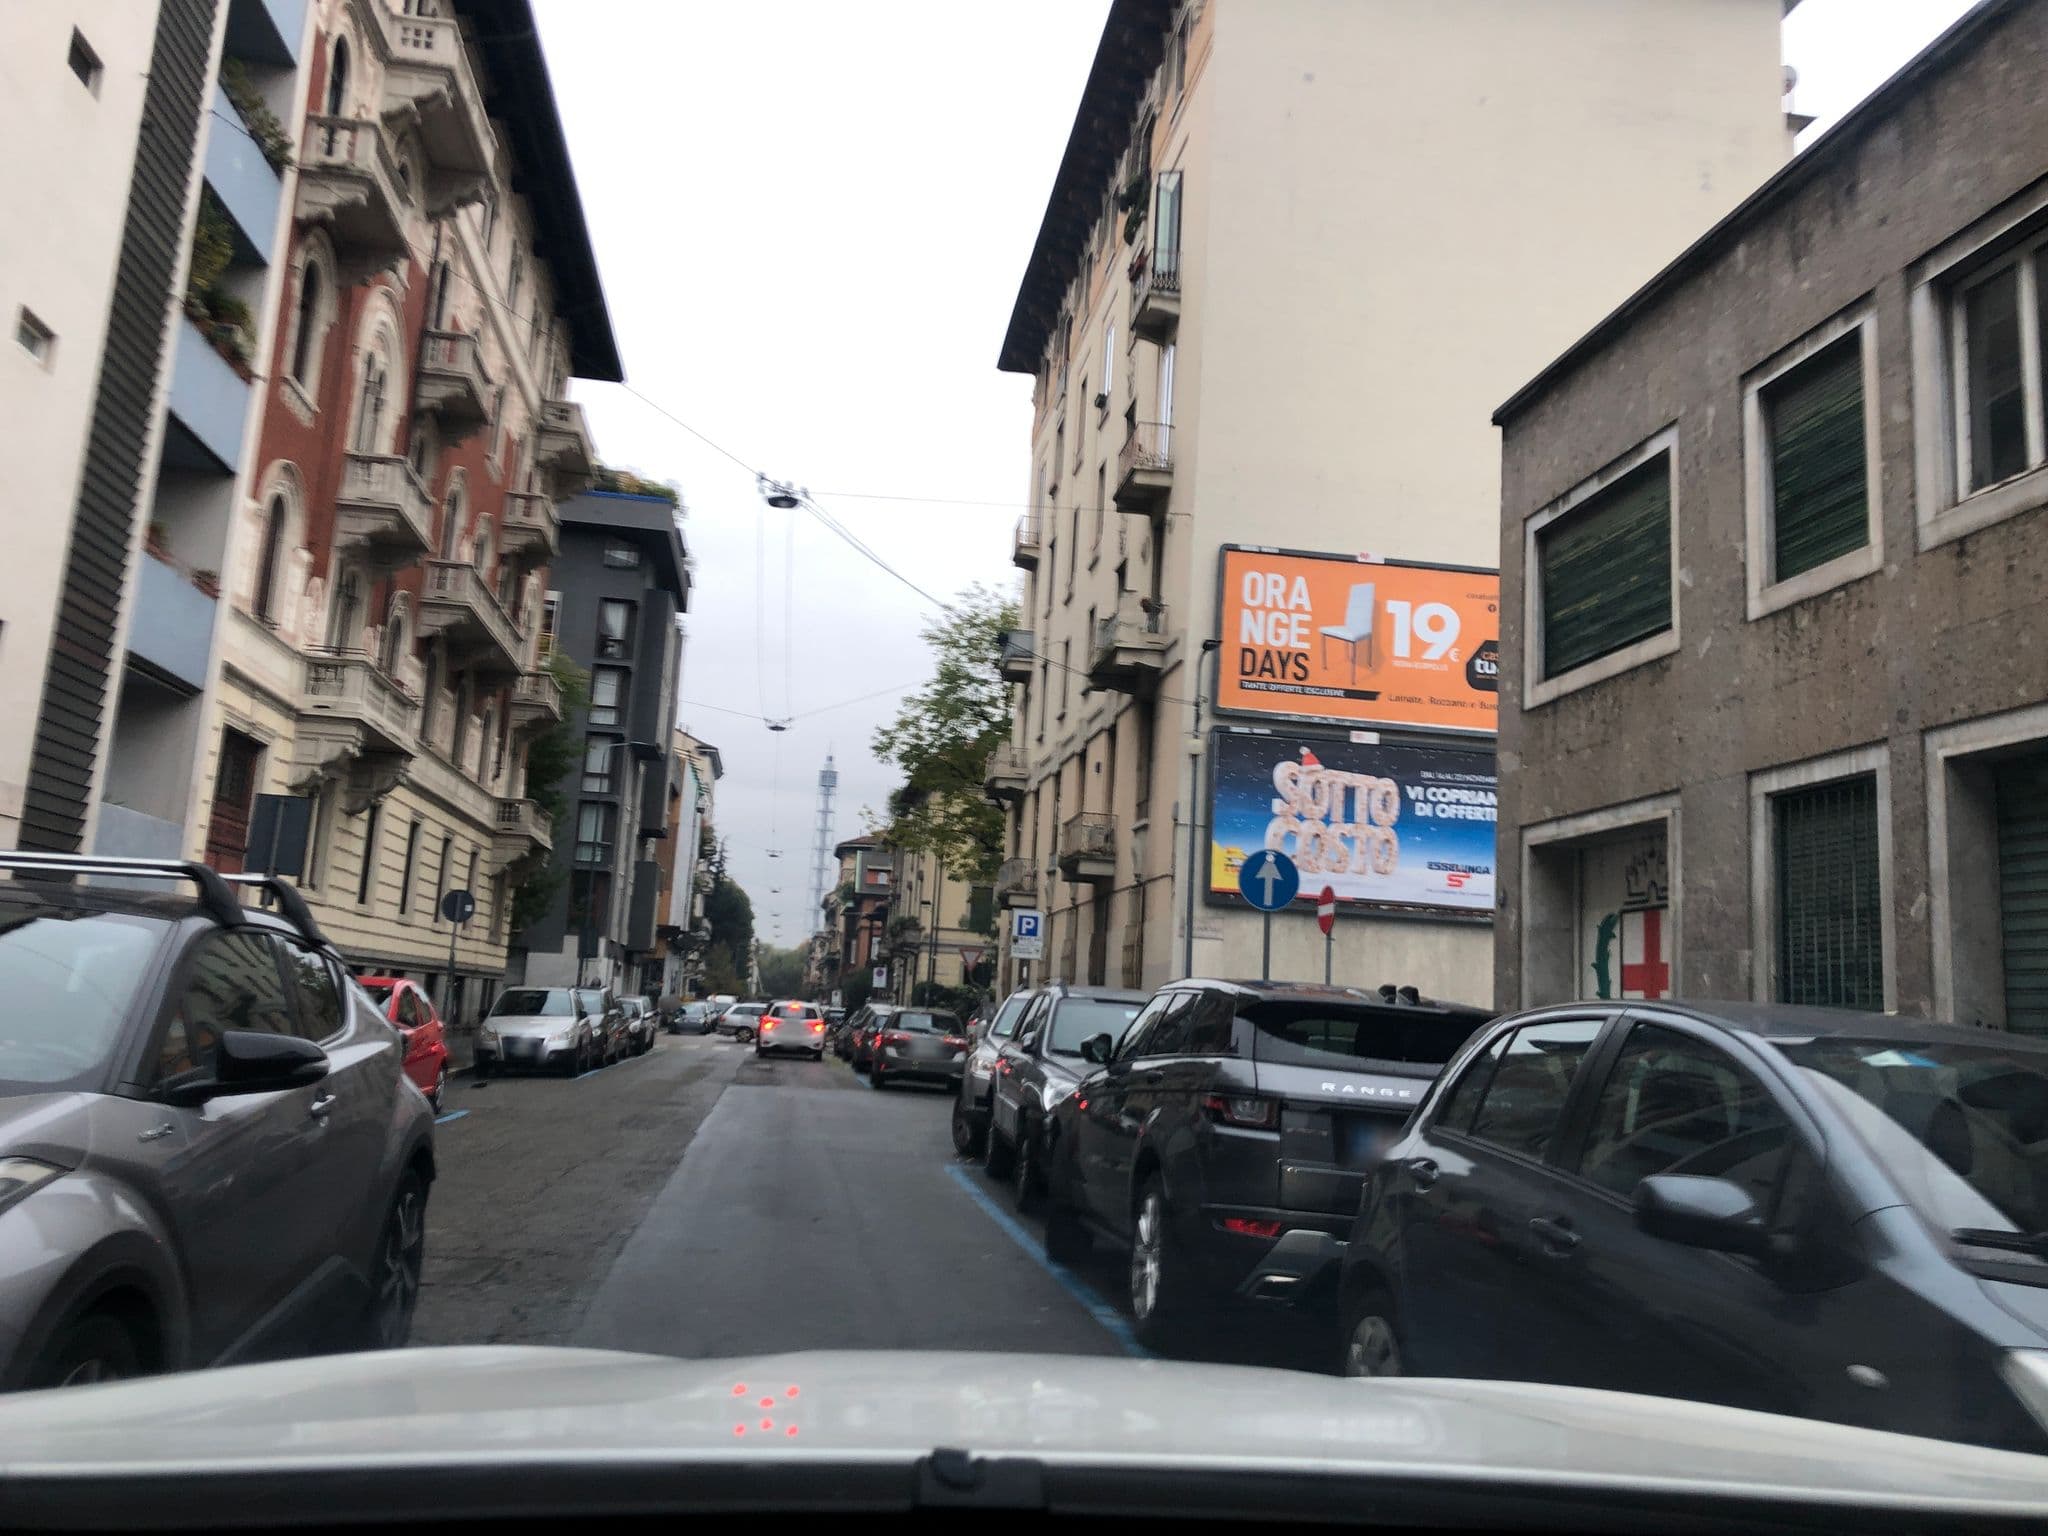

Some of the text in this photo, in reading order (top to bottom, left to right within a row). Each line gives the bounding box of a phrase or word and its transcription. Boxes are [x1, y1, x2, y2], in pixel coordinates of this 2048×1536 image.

[1242, 571, 1312, 612] ORA
[1240, 608, 1312, 649] NGE
[1240, 647, 1310, 681] DAYS
[1475, 658, 1499, 675] tu
[1271, 760, 1401, 827] SOTTO
[1405, 785, 1425, 800] VI
[1414, 801, 1433, 817] DI
[1264, 816, 1399, 876] COSTO
[1426, 861, 1491, 874] ESSELUNGA
[1021, 917, 1035, 934] P
[1321, 1082, 1412, 1098] RANGE
